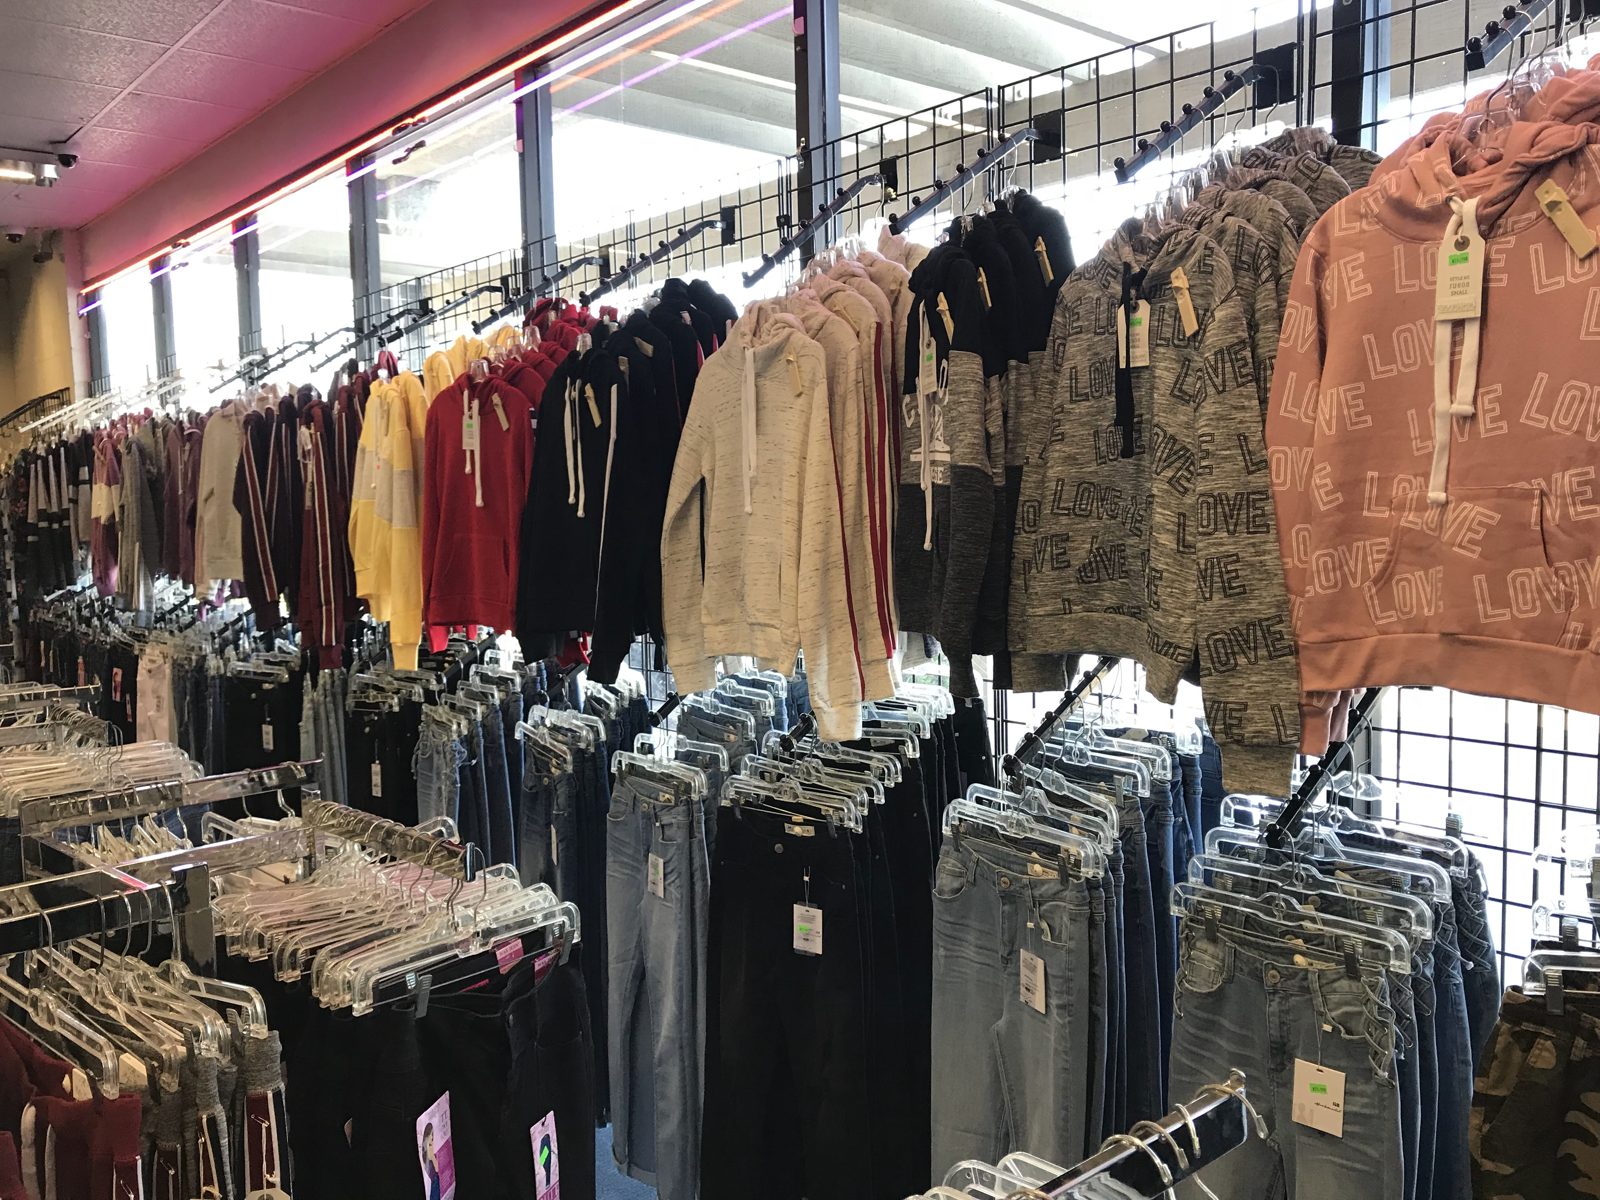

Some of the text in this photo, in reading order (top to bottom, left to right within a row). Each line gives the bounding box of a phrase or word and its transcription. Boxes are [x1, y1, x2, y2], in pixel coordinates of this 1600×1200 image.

[1393, 236, 1517, 294] LOE
[1093, 413, 1146, 467] LOE
[1407, 383, 1509, 457] LVE
[1304, 537, 1391, 597] OVE
[1362, 565, 1444, 626] LOV
[1200, 613, 1296, 679] OVE
